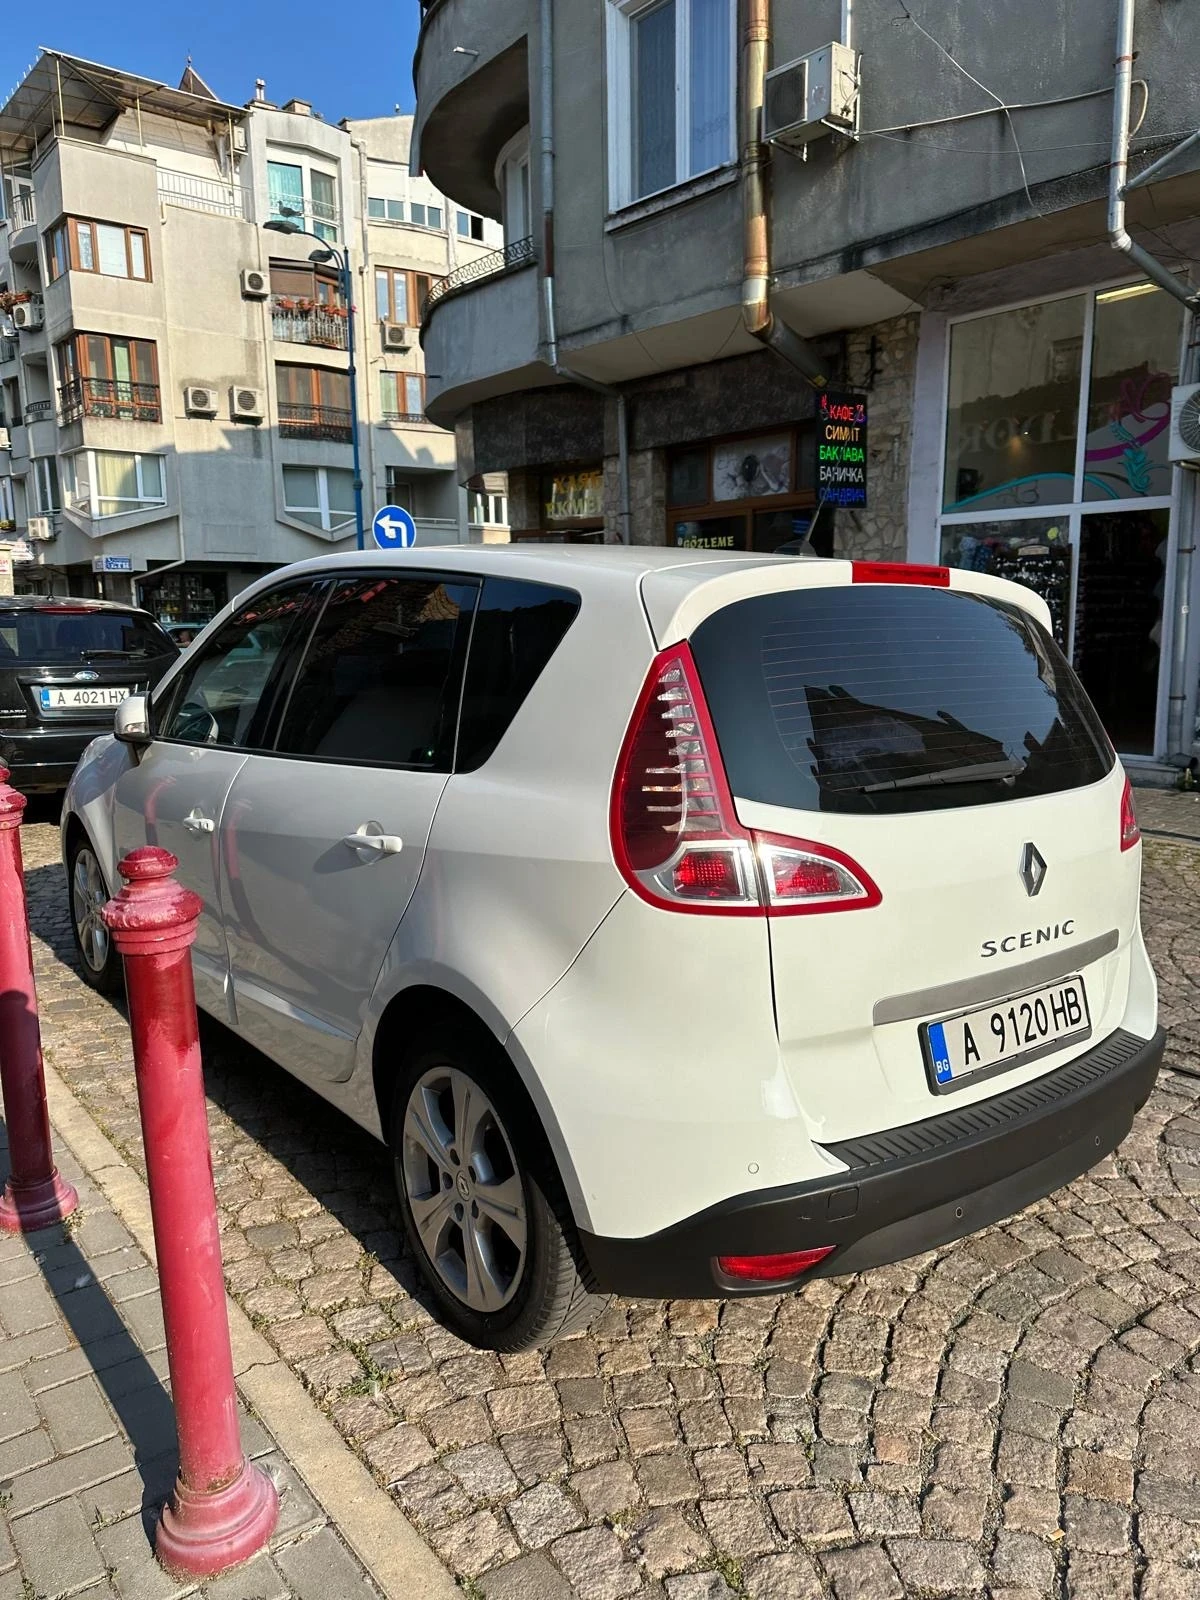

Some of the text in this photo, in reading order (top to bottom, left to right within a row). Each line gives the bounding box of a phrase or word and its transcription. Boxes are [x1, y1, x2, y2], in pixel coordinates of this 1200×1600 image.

[829, 404, 855, 421] КАФЕ
[825, 424, 860, 441] СИМИТ
[819, 445, 864, 462] БАКЛАВА
[819, 466, 864, 482] БАНИЧКА
[683, 535, 734, 549] GÖZLEME
[73, 691, 105, 705] 4021
[980, 919, 1075, 958] SCENIC
[963, 1022, 981, 1065] A
[990, 998, 1048, 1053] 9120
[936, 1058, 949, 1074] BG
